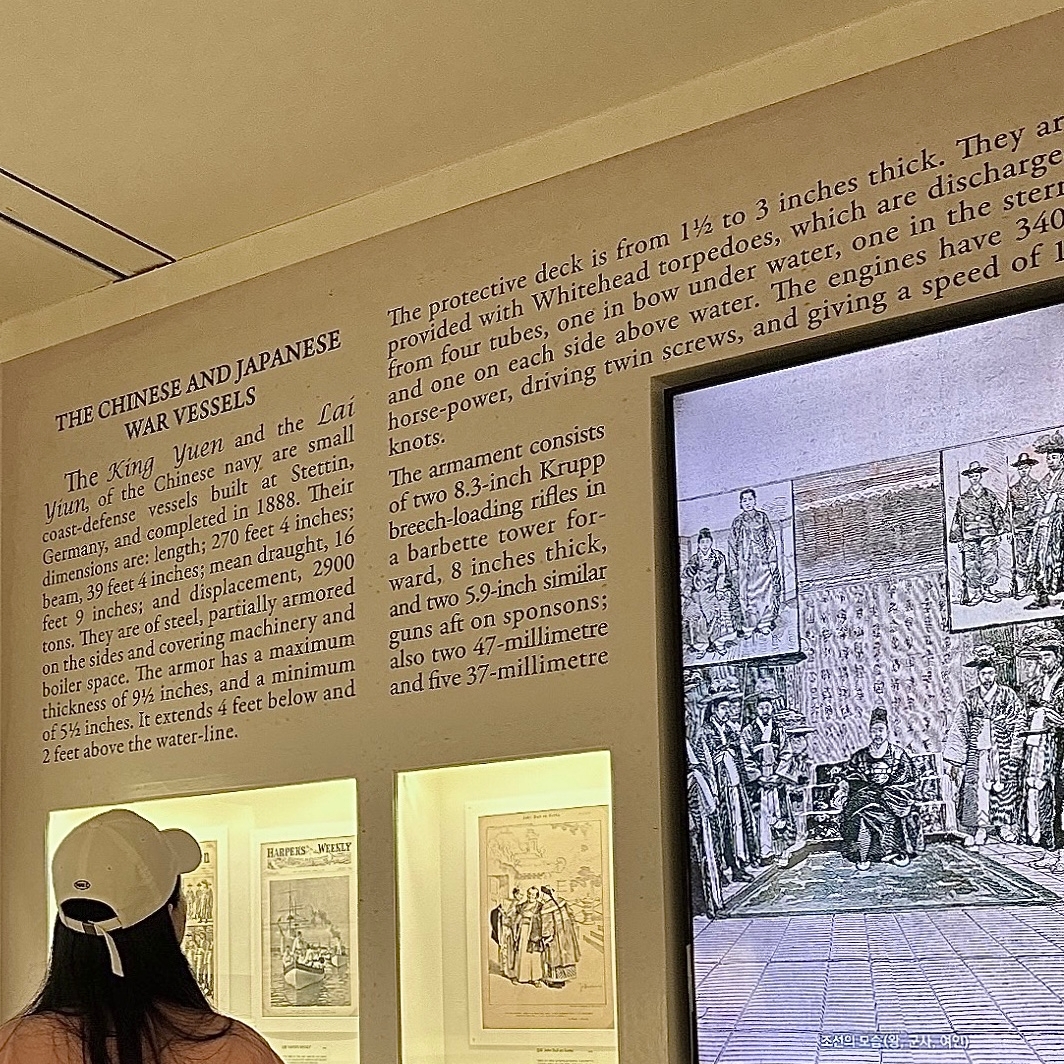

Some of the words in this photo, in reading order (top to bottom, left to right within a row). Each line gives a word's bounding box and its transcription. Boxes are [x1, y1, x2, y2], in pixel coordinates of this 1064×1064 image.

[386, 305, 422, 328] The
[428, 275, 527, 323] protective
[535, 253, 584, 284] deck
[591, 248, 608, 268] is
[616, 233, 671, 261] from
[722, 211, 746, 229] to
[755, 198, 769, 221] 3
[778, 177, 858, 213] inches
[868, 148, 945, 186] thick.
[955, 127, 1026, 160] They
[54, 405, 95, 432] THE
[97, 378, 183, 419] CHINESE
[185, 364, 232, 395] AND
[233, 329, 342, 385] JAPANESE
[123, 412, 170, 440] WAR
[172, 385, 256, 426] VESSELS
[44, 497, 90, 525] Yiun,
[97, 486, 115, 507] of
[121, 482, 145, 501] the
[153, 467, 215, 492] Chinese
[224, 454, 263, 475] navy
[271, 445, 298, 463] are
[308, 423, 355, 453] small
[63, 468, 99, 493] The
[106, 456, 155, 483] King
[172, 437, 225, 470] Yuen
[234, 423, 265, 448] and
[277, 416, 304, 437] the
[316, 395, 355, 426] Lai
[388, 466, 423, 488] The
[428, 444, 523, 479] armament
[529, 425, 605, 455] consists
[821, 1034, 855, 1048] 조선의
